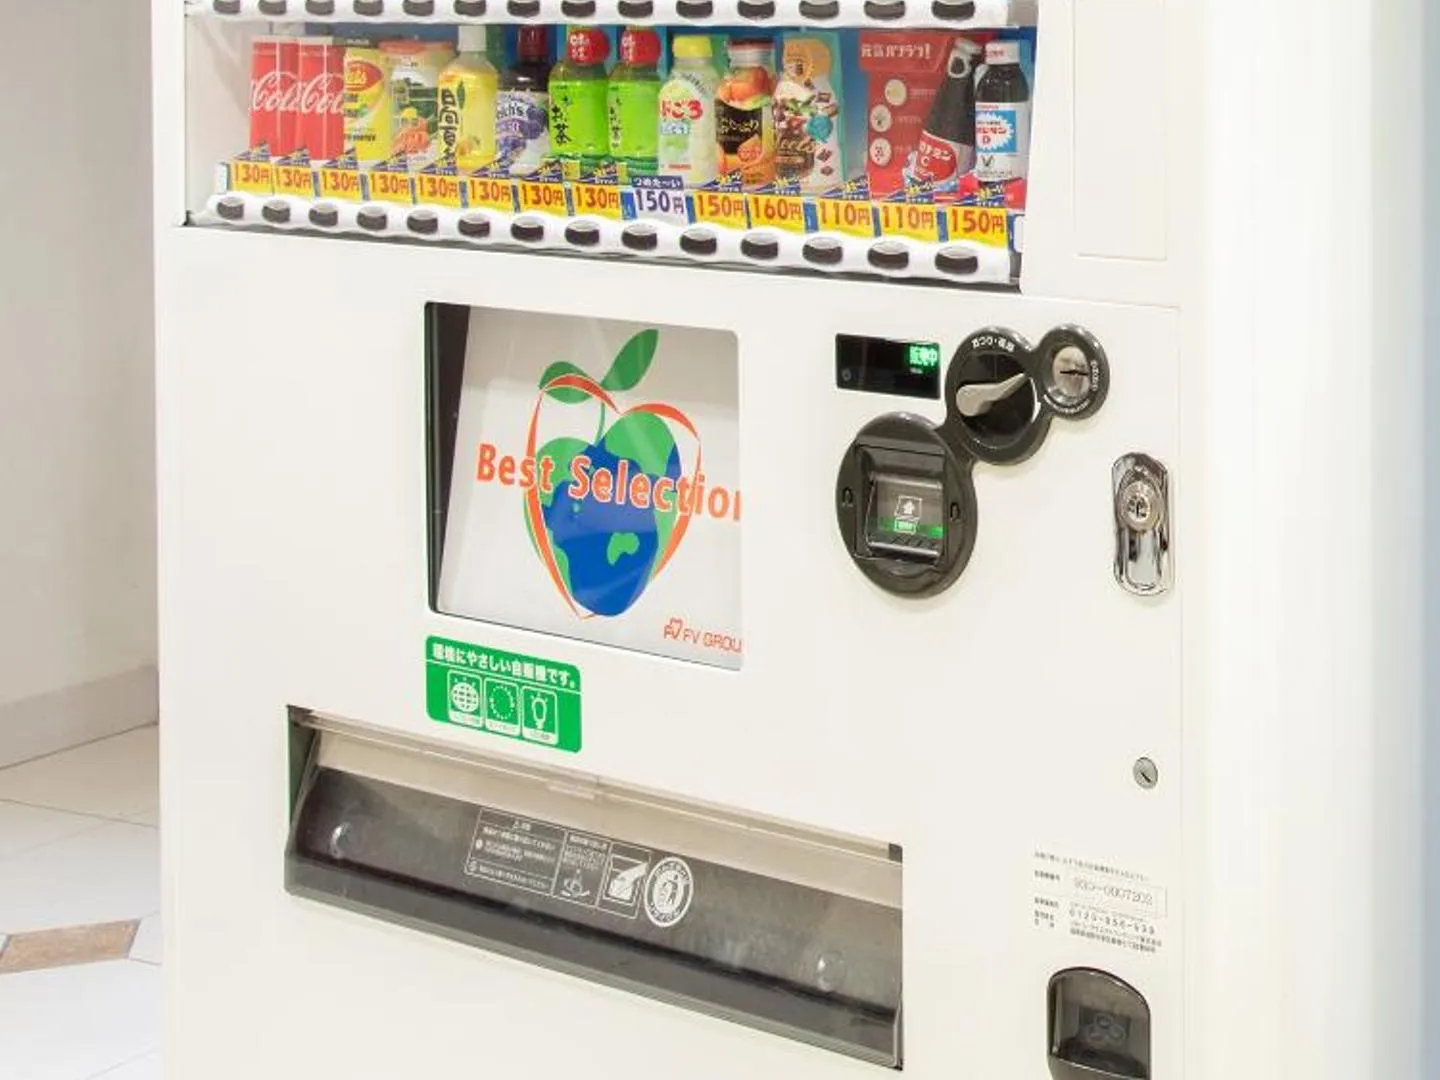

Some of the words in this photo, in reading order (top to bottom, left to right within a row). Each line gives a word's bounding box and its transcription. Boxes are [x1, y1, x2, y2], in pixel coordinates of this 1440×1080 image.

[235, 163, 269, 183] 130円
[276, 167, 311, 187] 130円
[322, 172, 360, 191] 130円
[371, 174, 410, 194] 130円
[419, 176, 458, 198] 130円
[470, 180, 511, 201] 130円
[521, 183, 564, 204] 130円
[575, 185, 619, 208] 130円
[636, 189, 684, 213] 150円
[698, 193, 744, 217] 150円
[754, 197, 801, 220] 160円
[820, 203, 870, 226] 110円
[881, 205, 935, 229] 110円
[951, 210, 1005, 235] 150円
[476, 443, 554, 493] Best
[704, 631, 741, 654] GROU
